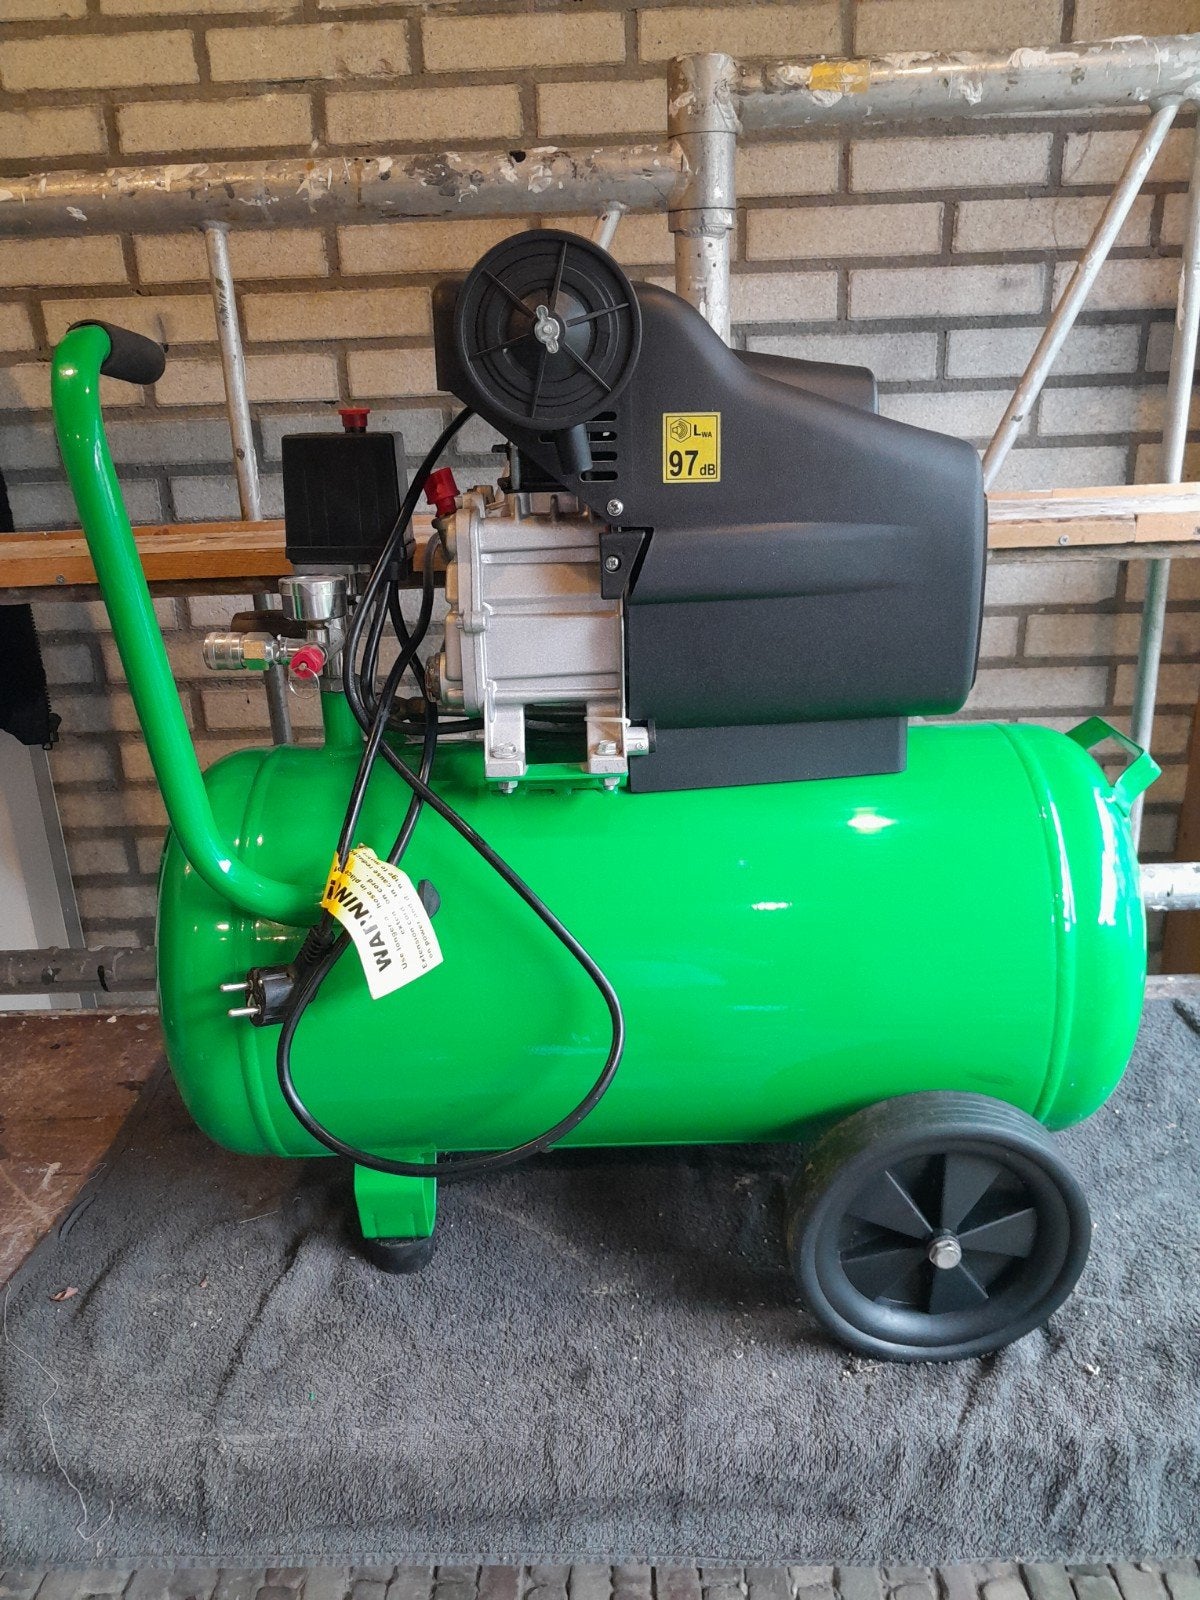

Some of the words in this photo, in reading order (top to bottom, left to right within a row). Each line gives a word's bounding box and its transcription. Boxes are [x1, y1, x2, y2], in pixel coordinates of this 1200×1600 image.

[669, 450, 699, 477] 97
[699, 463, 716, 476] dB
[366, 890, 382, 909] hose
[387, 924, 402, 952] longer
[416, 921, 431, 947] power
[409, 927, 428, 969] Extension
[426, 947, 434, 959] on
